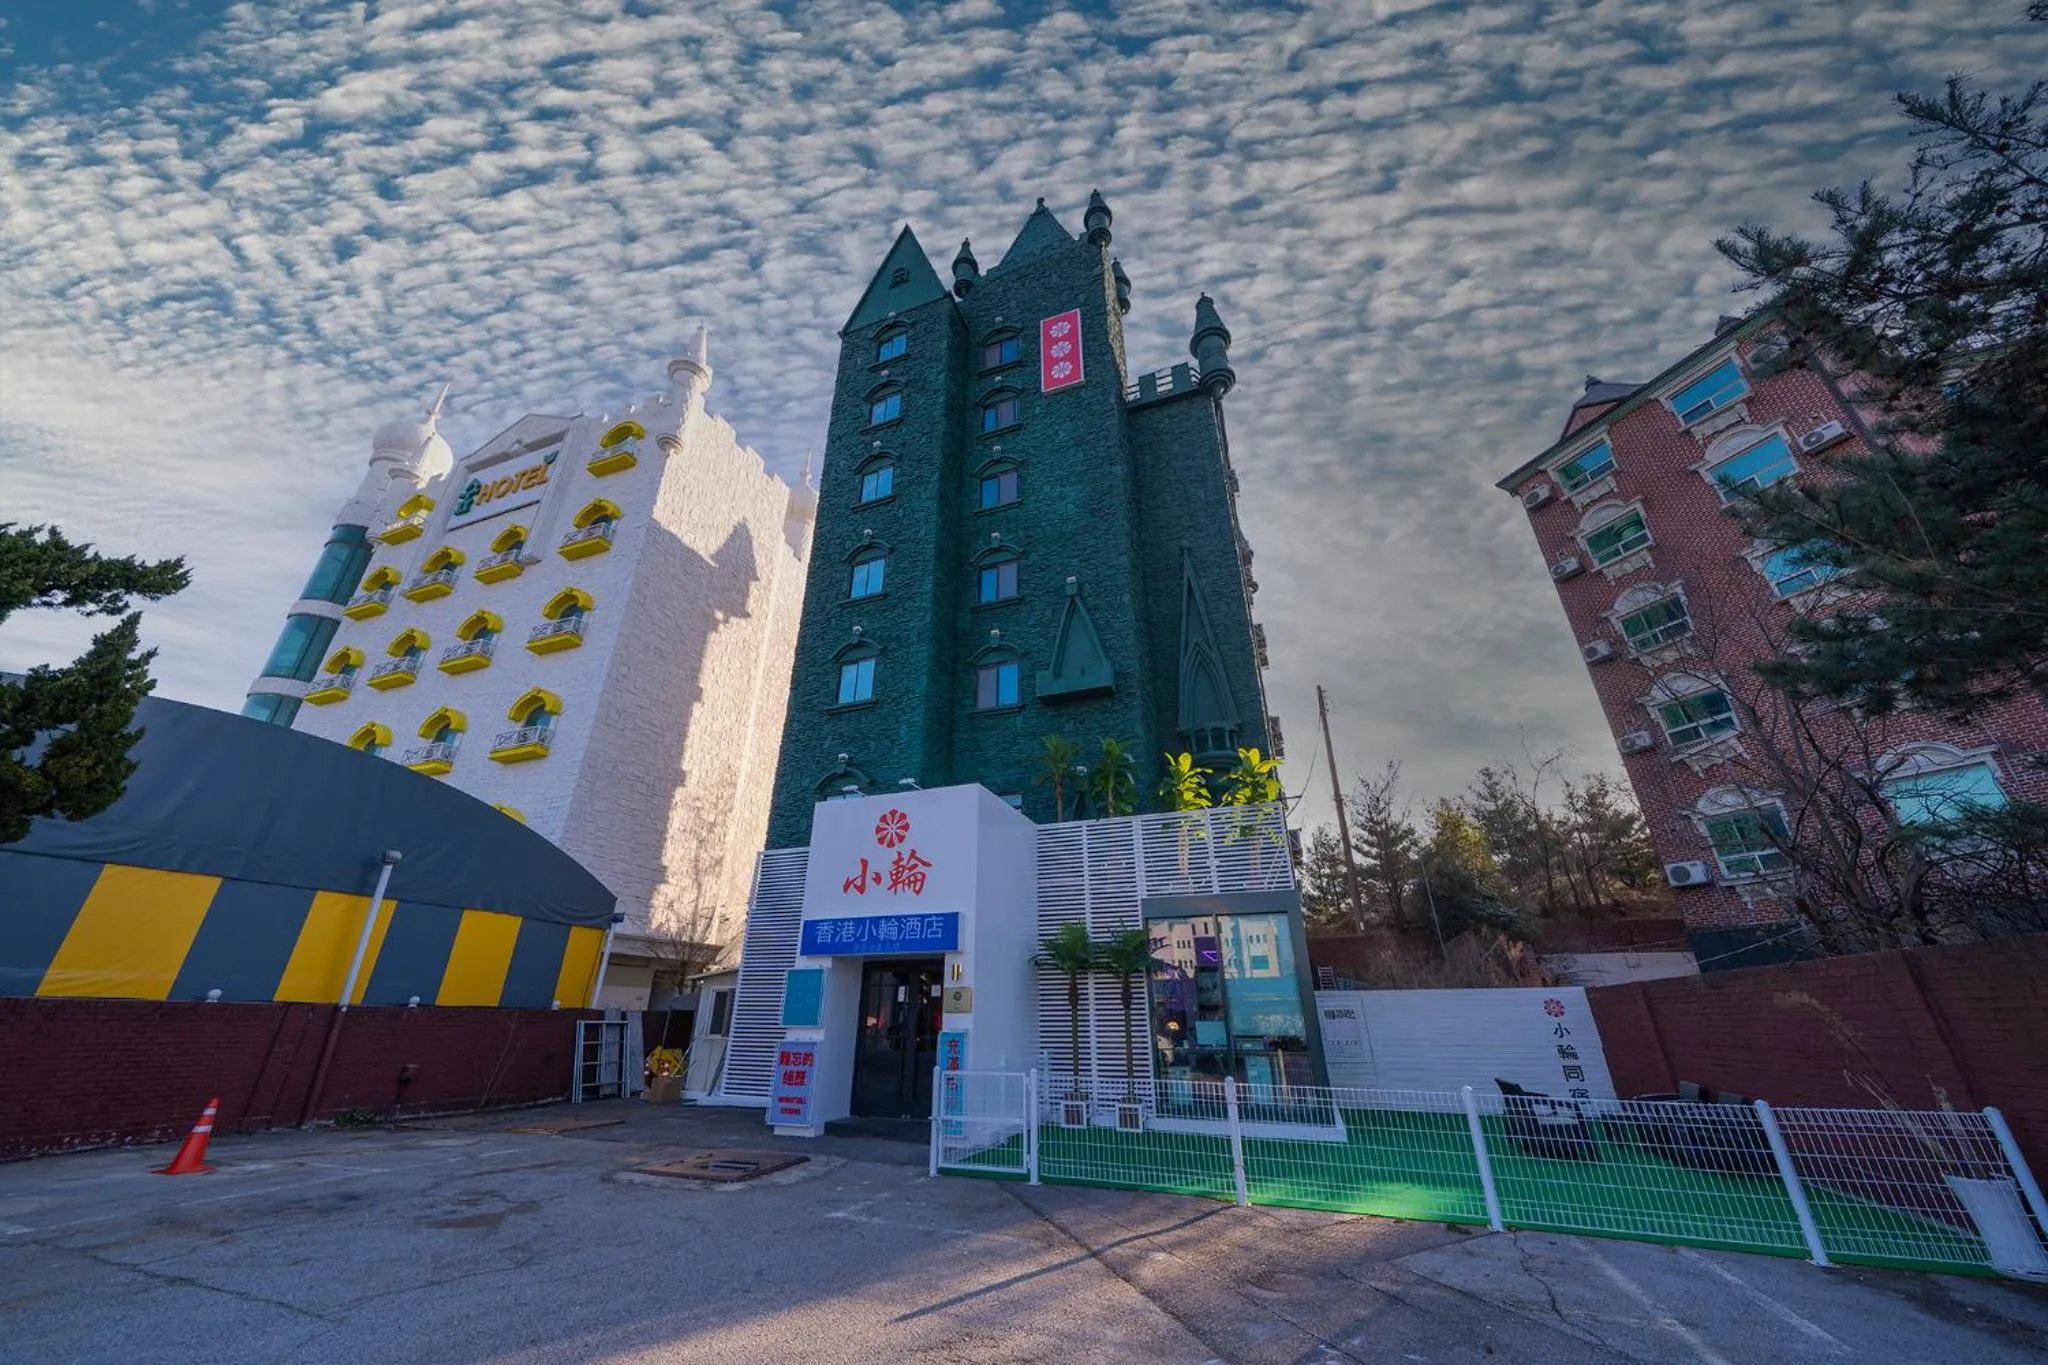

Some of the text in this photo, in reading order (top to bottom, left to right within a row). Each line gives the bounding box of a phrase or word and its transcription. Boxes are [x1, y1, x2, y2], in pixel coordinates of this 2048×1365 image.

[475, 464, 548, 505] HOTEL
[843, 849, 932, 896] 小輪
[816, 916, 945, 944] 香港小輪酒店
